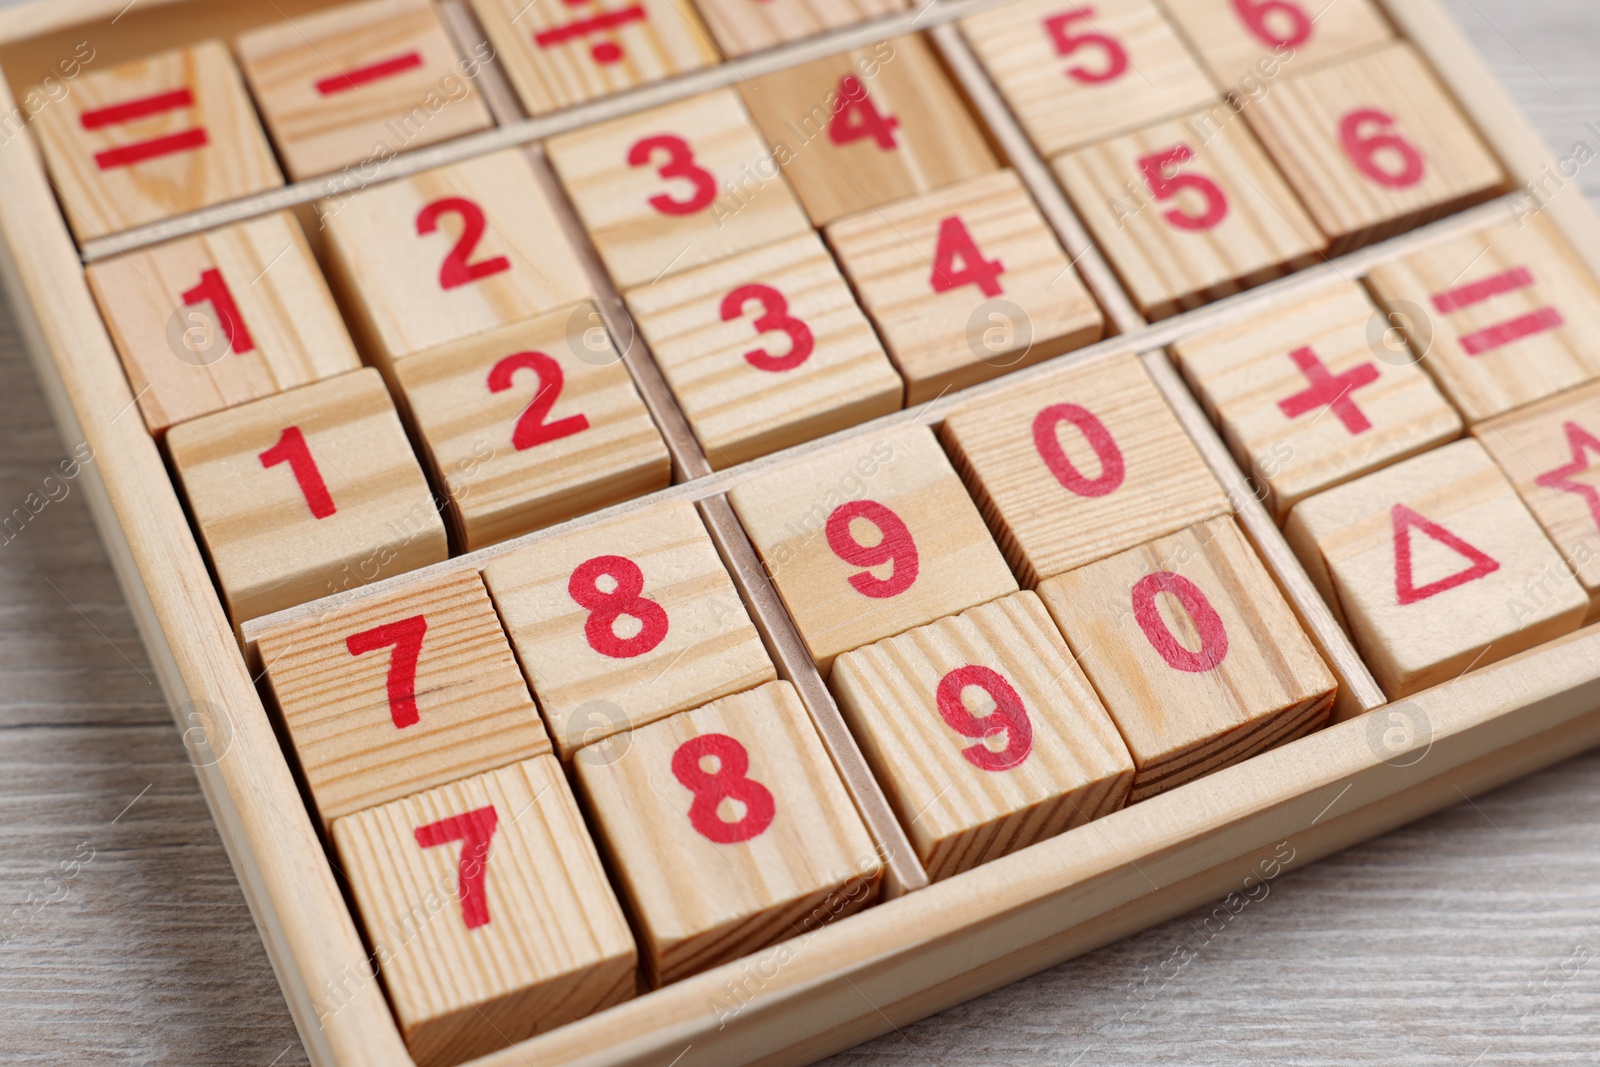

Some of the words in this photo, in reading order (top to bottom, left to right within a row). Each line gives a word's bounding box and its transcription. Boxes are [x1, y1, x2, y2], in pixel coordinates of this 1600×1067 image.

[1045, 9, 1127, 83] 5
[828, 74, 900, 151] 4
[1341, 110, 1422, 187] 6
[628, 135, 718, 216] 3
[1139, 147, 1227, 230] 5
[416, 196, 510, 290] 2
[930, 216, 1004, 297] 4
[182, 268, 255, 355] 1
[721, 283, 815, 372] 3
[487, 351, 590, 451] 2
[259, 426, 337, 520] 1
[1033, 404, 1124, 497] 0
[825, 500, 919, 598] 9
[568, 555, 668, 658] 8
[1132, 571, 1228, 672] 0
[346, 614, 428, 729] 7
[936, 665, 1032, 771] 9
[672, 734, 775, 844] 8
[414, 805, 498, 930] 7
